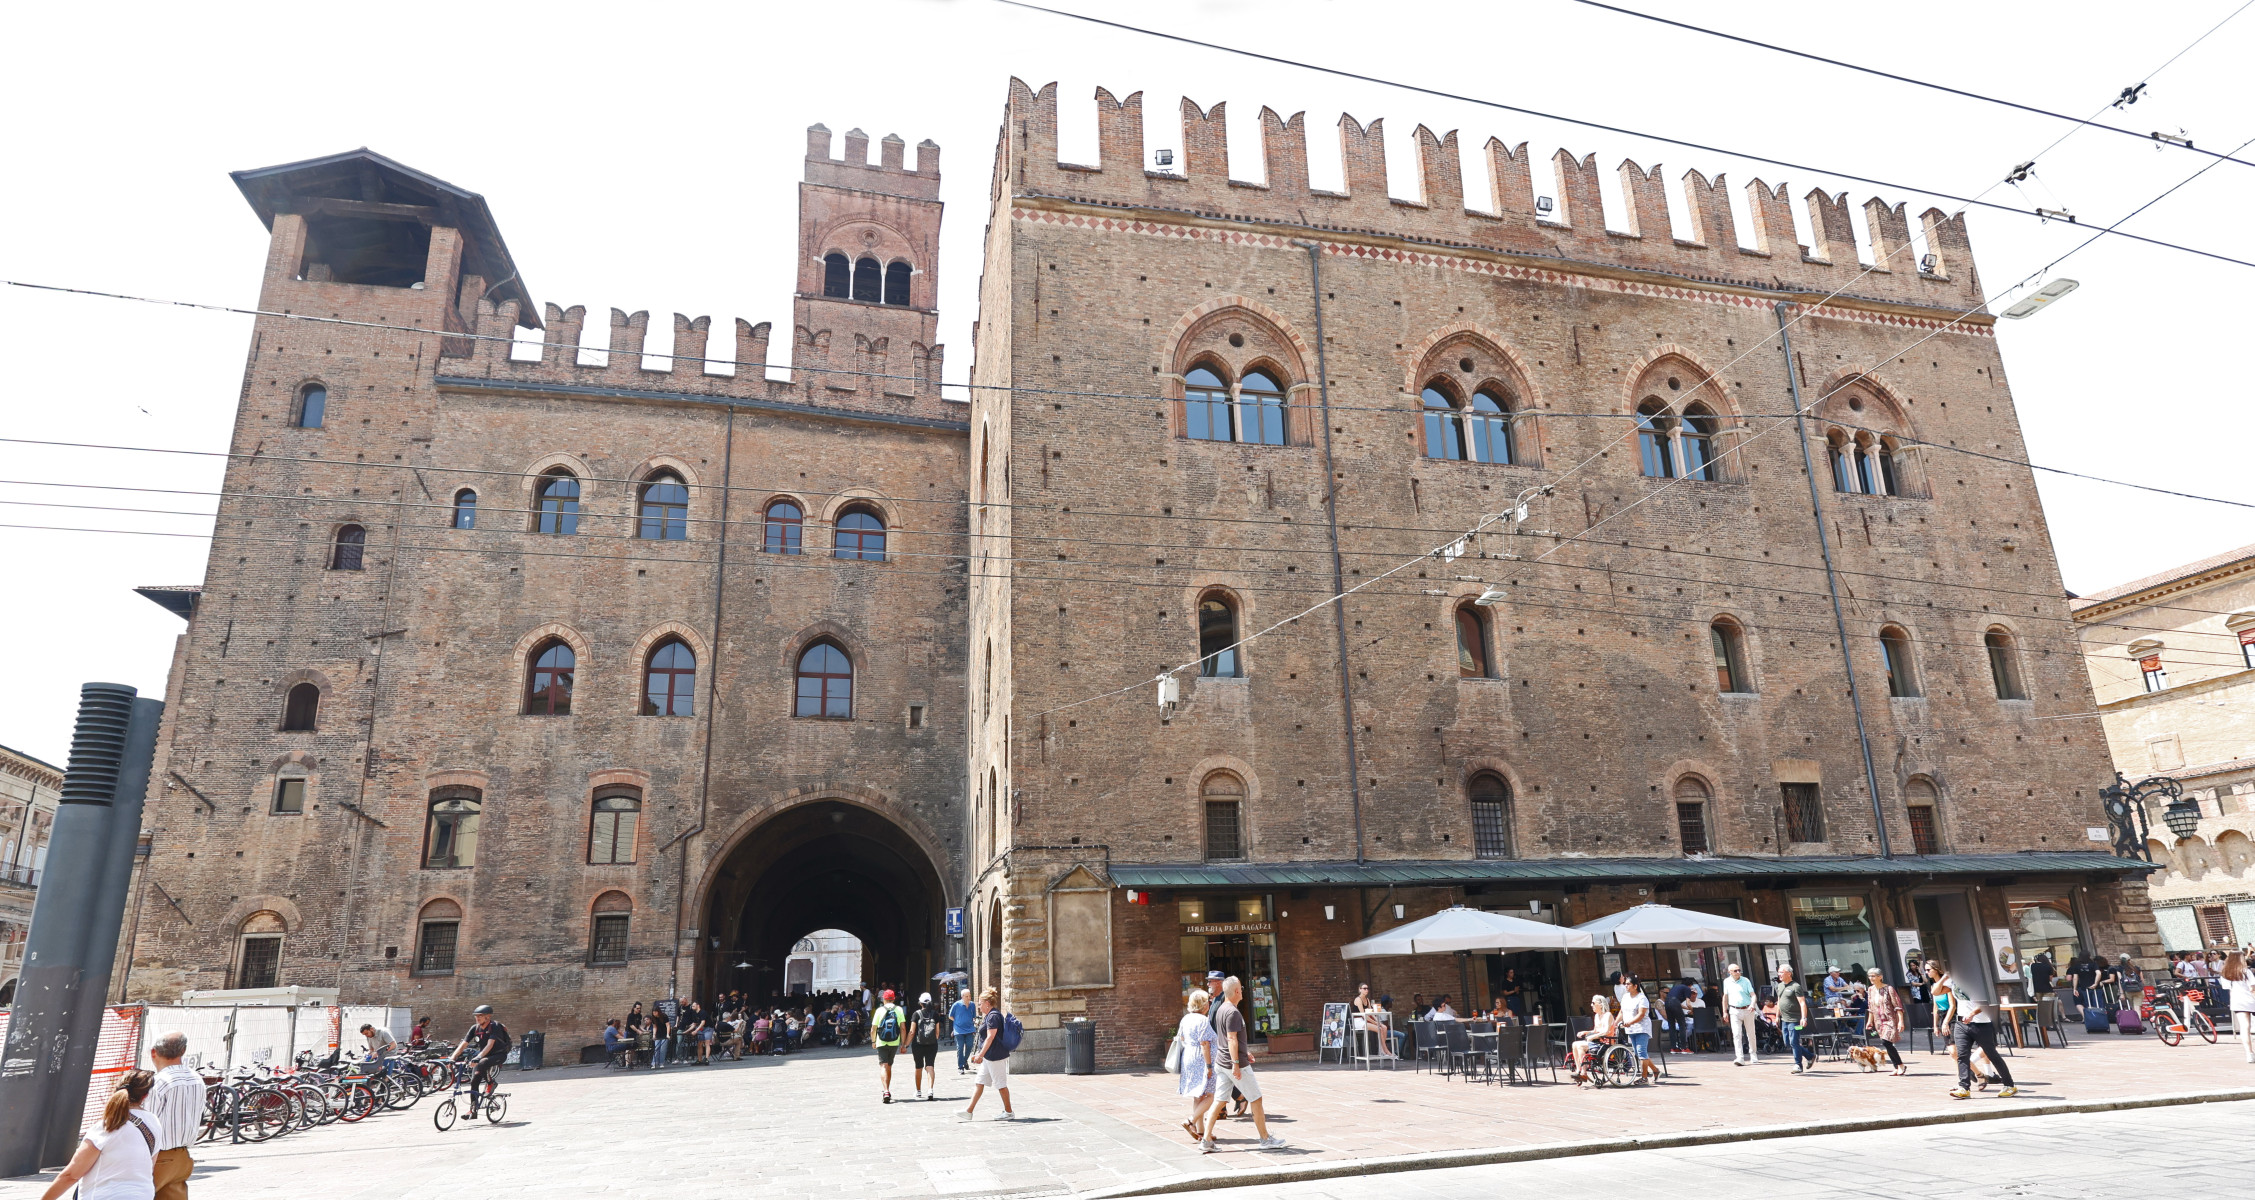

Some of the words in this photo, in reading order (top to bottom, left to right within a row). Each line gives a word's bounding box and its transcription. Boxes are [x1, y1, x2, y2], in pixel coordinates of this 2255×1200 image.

[949, 910, 960, 926] T
[1825, 919, 1837, 927] Bike
[1187, 925, 1223, 933] LIBRERIA
[1224, 924, 1239, 932] PER
[1241, 923, 1272, 931] RAGAZZI
